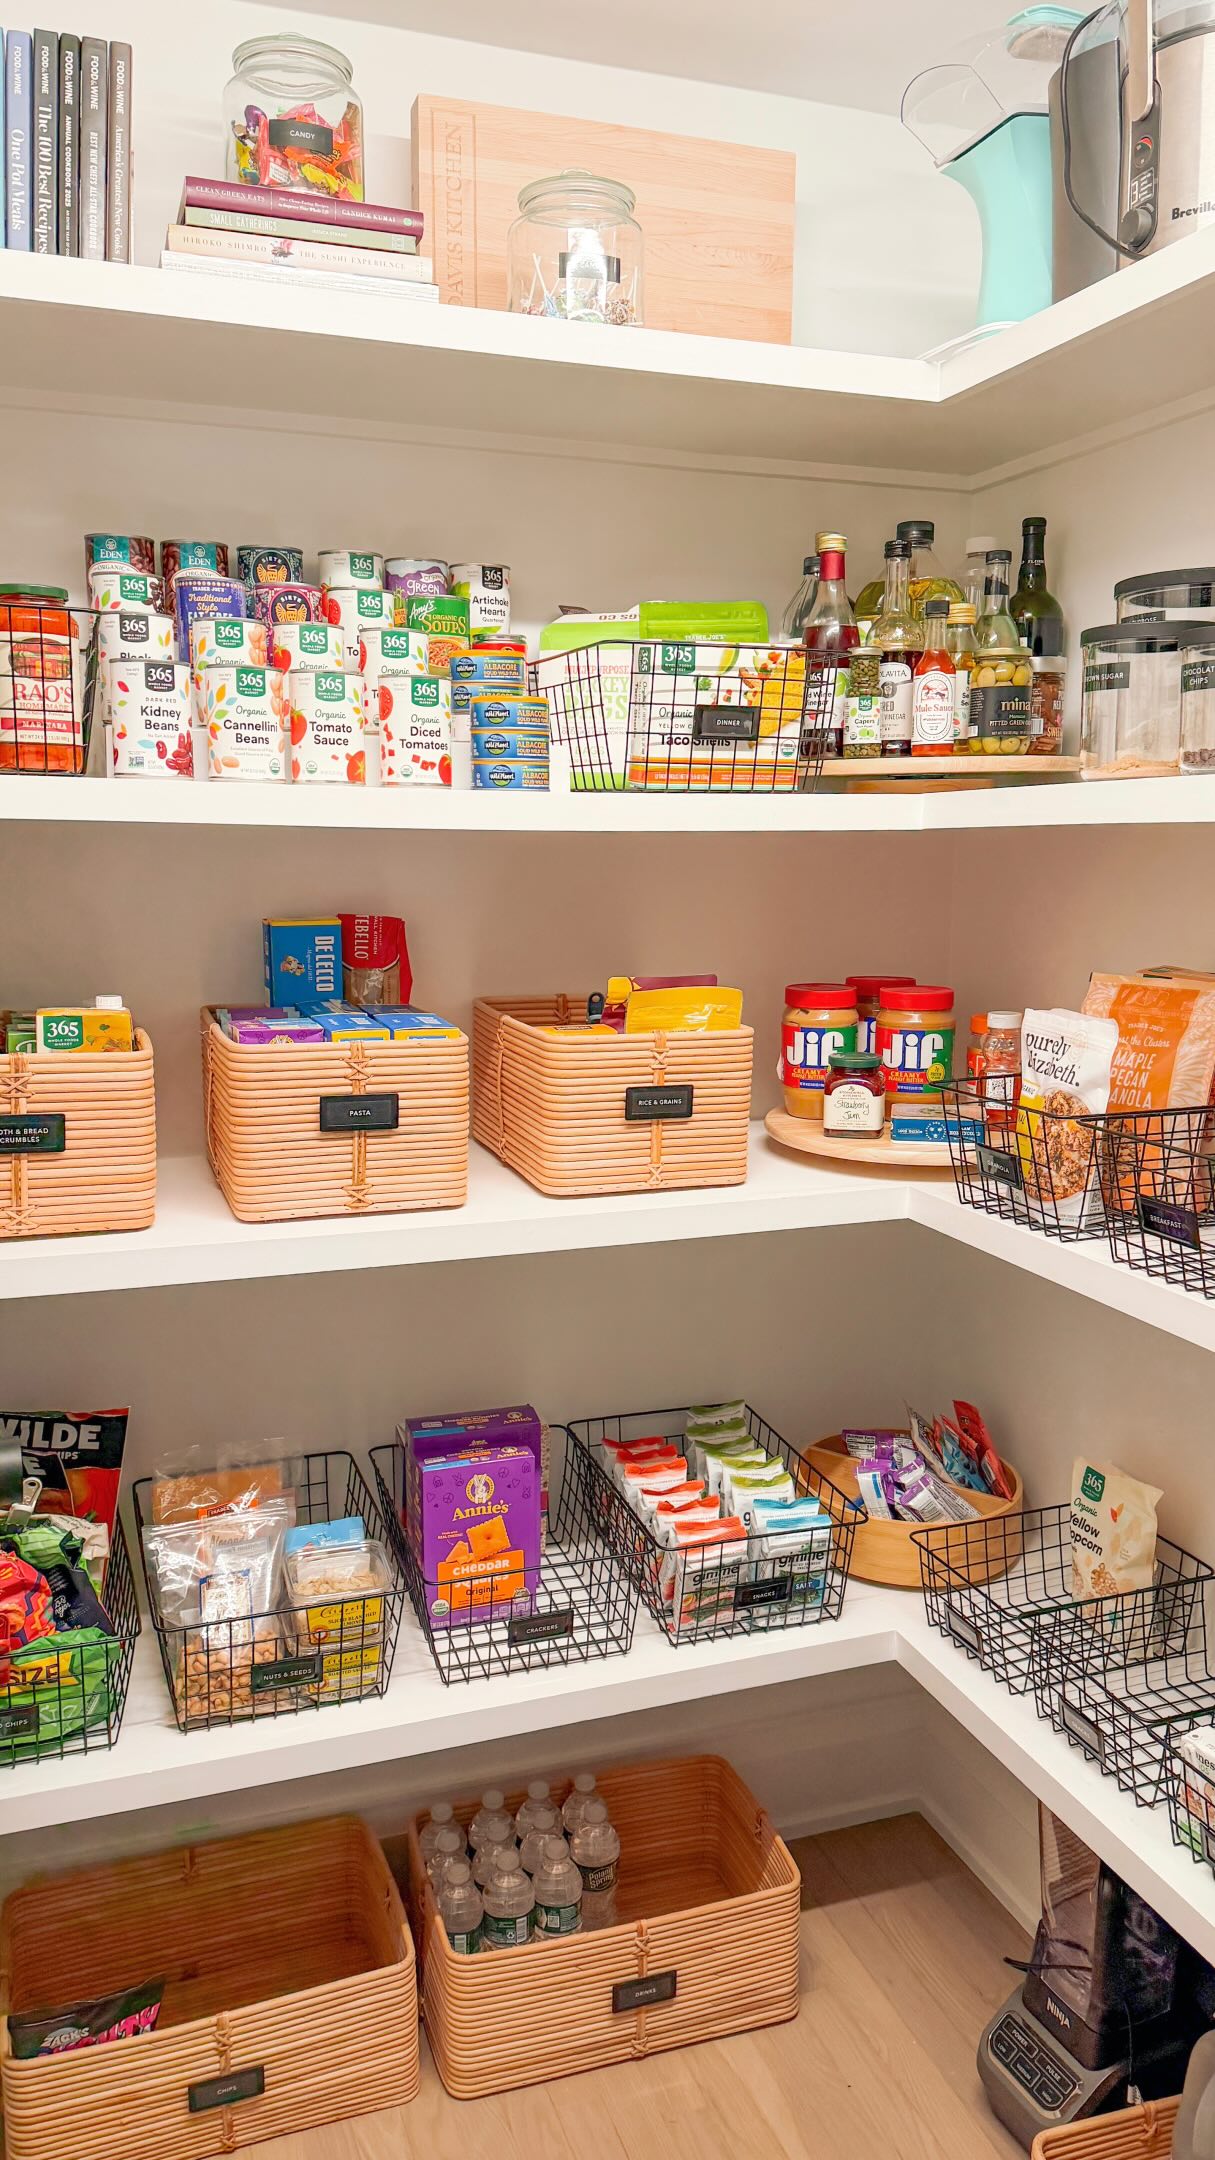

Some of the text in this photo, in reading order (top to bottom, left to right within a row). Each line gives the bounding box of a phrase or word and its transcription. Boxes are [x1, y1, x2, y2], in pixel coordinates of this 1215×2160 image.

[90, 131, 98, 146] BEST
[289, 129, 315, 140] CANDY
[115, 125, 124, 168] America's
[89, 147, 97, 164] NEW
[11, 129, 25, 231] One Pot Meals
[35, 104, 52, 254] The 100 Best Recipes
[89, 165, 97, 185] CHEFS
[446, 122, 463, 236] KITCHEN
[115, 169, 123, 202] Greatest
[195, 185, 265, 203] CLEAN GREEN EATS
[210, 213, 277, 232] SMALL GATHERINGS
[114, 227, 122, 255] Cooks
[183, 236, 267, 253] HIROKO SHIMBO
[300, 251, 405, 271] THE SUSHI EXPERIENCE
[100, 548, 123, 559] EDEN
[188, 555, 211, 566] EDEN
[352, 557, 372, 571] 365
[484, 570, 502, 582] 365
[122, 579, 145, 592] 365
[188, 593, 232, 604] Traditional
[359, 595, 381, 609] 365
[196, 603, 219, 614] Style
[408, 600, 437, 626] Amy's
[479, 606, 506, 617] Hearts
[122, 619, 147, 633] 365
[217, 624, 241, 639] 365
[421, 614, 467, 635] SOUPS
[302, 630, 326, 646] 365
[384, 635, 407, 649] 365
[640, 649, 649, 672] 365
[147, 667, 173, 683] 365
[380, 664, 410, 675] Organic
[1101, 672, 1124, 680] SUGAR
[1183, 667, 1215, 677] CHOCOLAT
[239, 672, 264, 688] 365
[318, 676, 343, 692] 365
[1189, 677, 1209, 686] CHIPS
[15, 683, 72, 705] RAO'S
[413, 682, 437, 698] 365
[915, 703, 954, 713] Mule Sauce
[1001, 697, 1031, 711] mina
[140, 705, 182, 721] Kidney
[235, 705, 268, 718] Organic
[314, 708, 347, 721] Organic
[658, 706, 693, 719] Organic
[22, 720, 67, 730] MARNARA
[144, 720, 180, 732] Beans
[223, 719, 278, 733] Cannellini
[410, 713, 441, 726] Organic
[716, 719, 741, 727] DINNER
[854, 718, 875, 727] Capers
[309, 721, 353, 734] Tomato
[409, 726, 441, 738] Diced
[235, 732, 270, 745] Beans
[313, 734, 349, 746] Sauce
[399, 738, 449, 751] Tomatoes
[659, 734, 690, 746] Taco
[354, 914, 369, 960] TEBELLO
[314, 935, 335, 992] DE CECCO
[47, 1019, 79, 1038] 365
[786, 1031, 845, 1067] Jif
[882, 1033, 944, 1069] Jif
[1026, 1032, 1072, 1062] purely
[1112, 1049, 1157, 1070] MAPLE
[793, 1067, 821, 1076] CREAMY
[890, 1070, 921, 1078] CREAMY
[1027, 1049, 1080, 1088] lizabeth.
[1109, 1067, 1150, 1089] PECAN
[638, 1099, 653, 1107] RICE
[659, 1098, 682, 1106] GRAINS
[1108, 1087, 1152, 1109] ANOLA
[349, 1109, 371, 1117] PASTA
[842, 1110, 861, 1120] Jam
[23, 1127, 49, 1135] BREAD
[0, 1136, 40, 1144] CRUMBLES
[987, 1160, 1010, 1174] GRANOLA
[1150, 1214, 1182, 1229] BREAKFAST
[497, 1450, 529, 1459] Annie's
[1084, 1472, 1103, 1492] 365
[451, 1500, 509, 1522] Annie's
[1073, 1497, 1098, 1517] Organic
[1070, 1510, 1100, 1538] Yellow
[1070, 1528, 1103, 1556] opcorn
[752, 1590, 776, 1600] SNACKS
[526, 1623, 559, 1634] CRACKERS
[263, 1672, 282, 1681] NUTS
[289, 1668, 312, 1677] SEEDS
[5, 1719, 28, 1728] CHIPS
[588, 1865, 613, 1882] Poland
[589, 1873, 614, 1890] Spring
[634, 1986, 657, 1998] DRINKS
[1045, 1996, 1071, 2029] NINJA
[1011, 2029, 1029, 2047] POWER
[1045, 2064, 1061, 2082] PULSE
[216, 2084, 238, 2095] CHIPS
